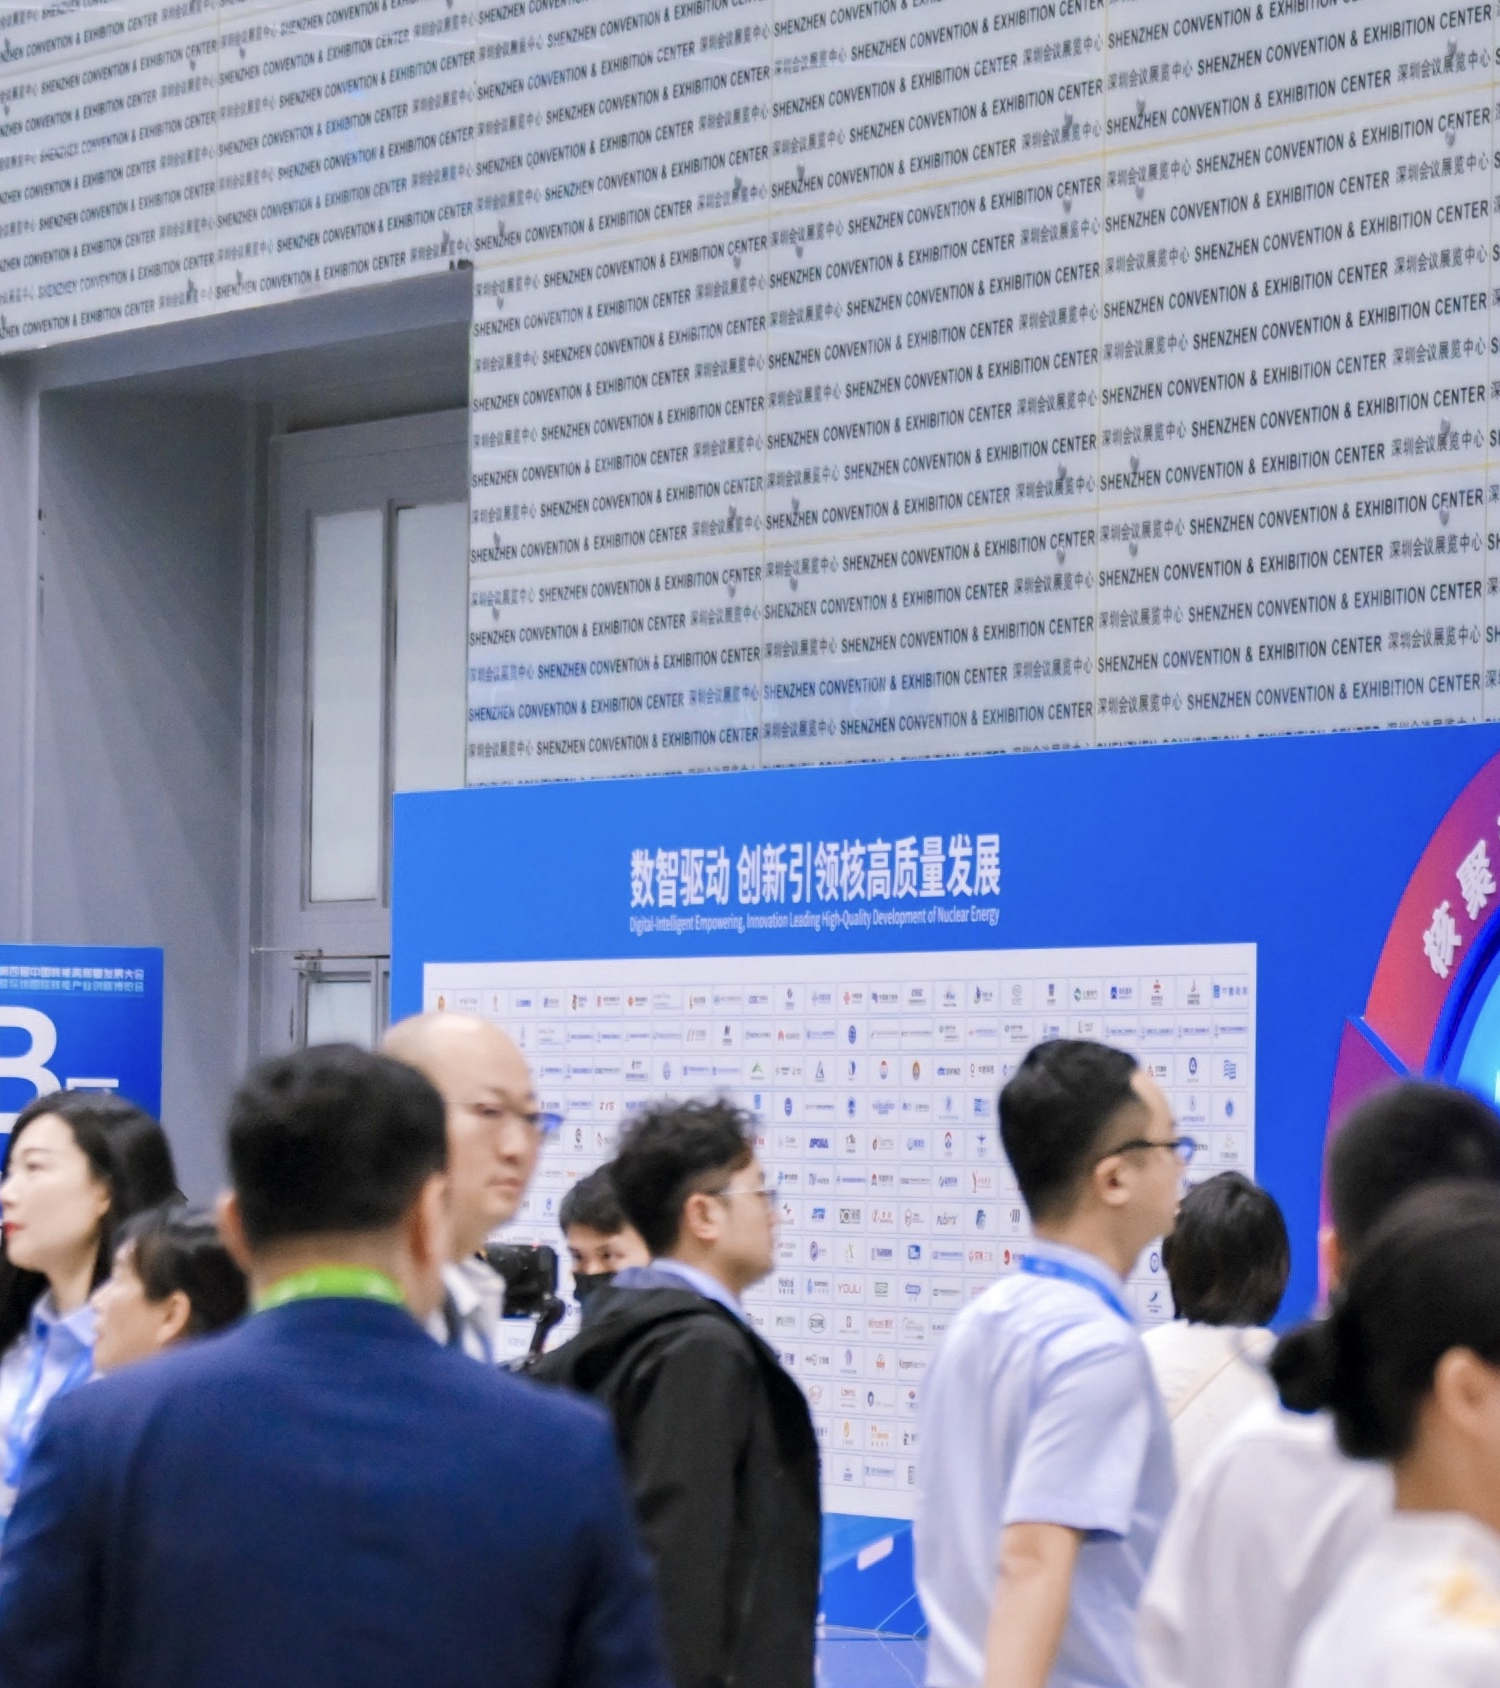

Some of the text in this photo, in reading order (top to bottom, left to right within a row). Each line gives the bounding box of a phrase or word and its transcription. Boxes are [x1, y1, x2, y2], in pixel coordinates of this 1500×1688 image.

[276, 201, 473, 253] SHENZHEN CONVENTION & EXHIBITION CENTER
[473, 355, 765, 413] SHENZHEN CONVENTION & EXHIBITION CENTER 深圳会议展览中心
[764, 571, 1094, 620] SHENZHEN CONVENTION & EXHIBITION CENTER 深圳会议展览中心
[630, 833, 1001, 909] 数智驱动 创新引领核高质量发展
[746, 909, 788, 929] Innovation
[789, 909, 821, 932] Leading
[822, 908, 871, 930] High-Quality
[872, 906, 926, 928] Development
[927, 905, 937, 923] of
[937, 905, 970, 923] Nuclear
[970, 904, 1001, 927] Energy
